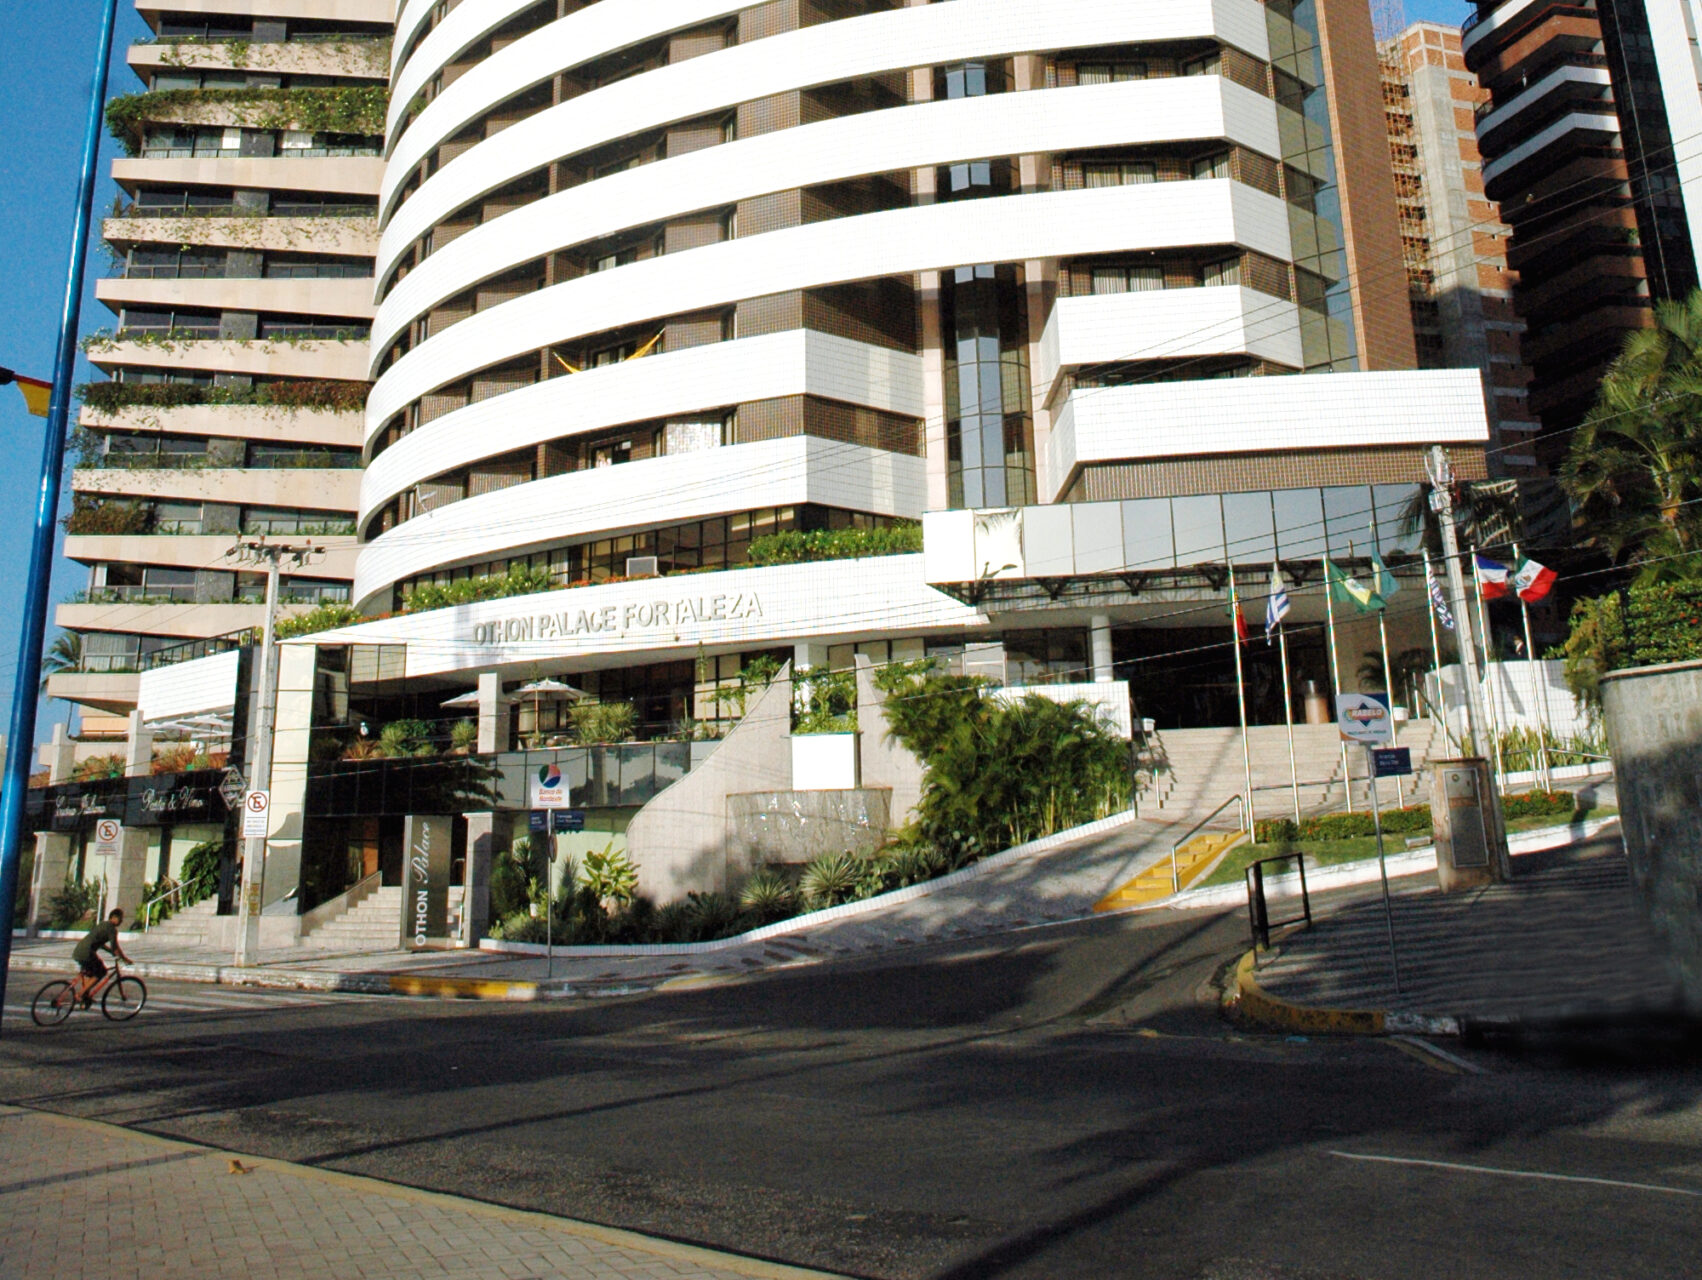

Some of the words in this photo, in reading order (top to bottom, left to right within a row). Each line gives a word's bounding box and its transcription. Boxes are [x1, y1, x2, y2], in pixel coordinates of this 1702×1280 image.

[472, 618, 533, 645] OTHON
[538, 605, 616, 638] PALACE
[622, 592, 763, 629] FORTALEZA
[411, 821, 430, 884] Palace
[415, 888, 428, 946] OTHON
